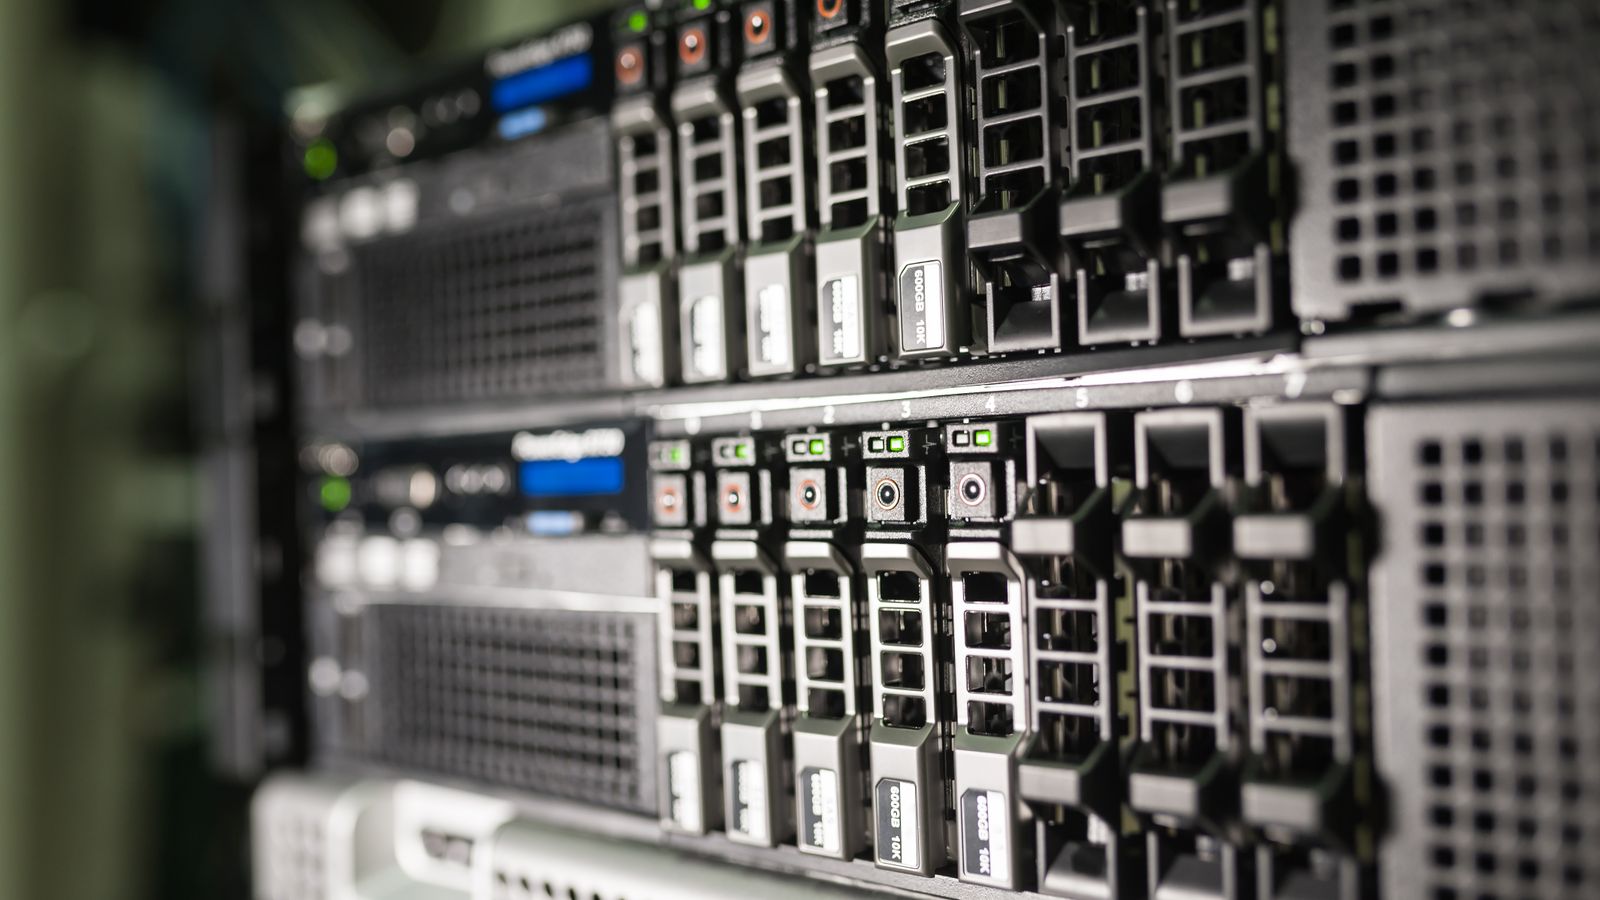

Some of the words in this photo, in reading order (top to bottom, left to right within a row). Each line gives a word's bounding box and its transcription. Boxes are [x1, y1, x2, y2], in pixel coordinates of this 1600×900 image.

[914, 269, 925, 312] 600GB
[916, 319, 926, 344] 10K
[823, 405, 835, 424] 2
[901, 400, 911, 418] 3
[984, 395, 996, 412] 4
[1075, 388, 1089, 408] 5
[890, 785, 900, 828] 600GB
[976, 795, 989, 841] 600GB
[891, 835, 901, 860] 10K
[979, 847, 990, 874] 10K
